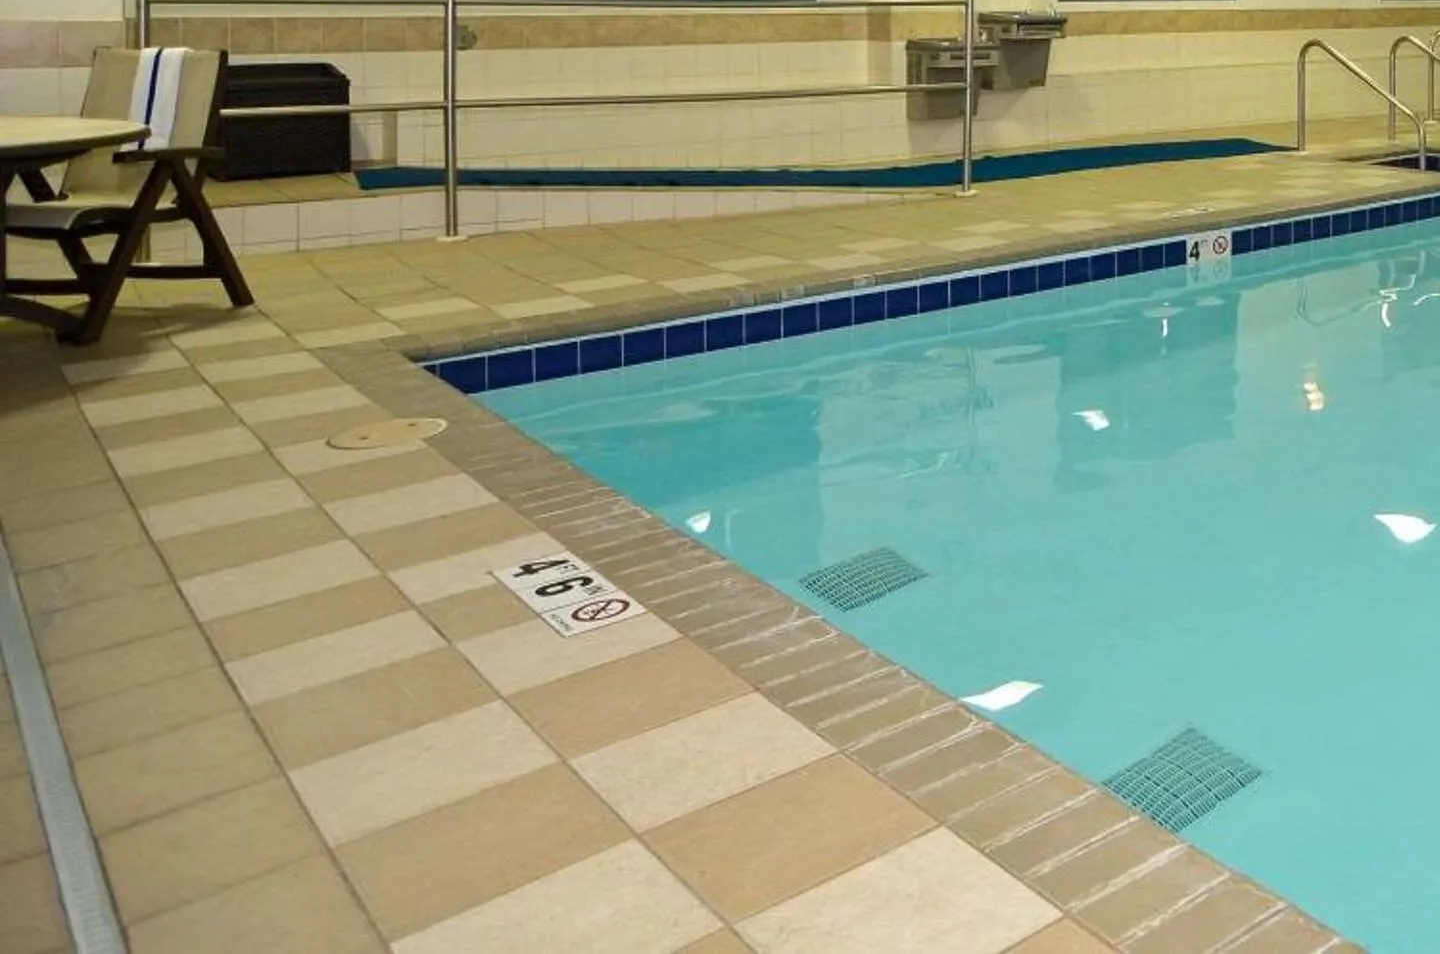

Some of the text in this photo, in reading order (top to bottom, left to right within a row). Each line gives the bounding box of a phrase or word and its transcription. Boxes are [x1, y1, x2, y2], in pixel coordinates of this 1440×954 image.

[1189, 240, 1200, 262] 4
[512, 559, 571, 578] 4
[535, 576, 594, 597] 6
